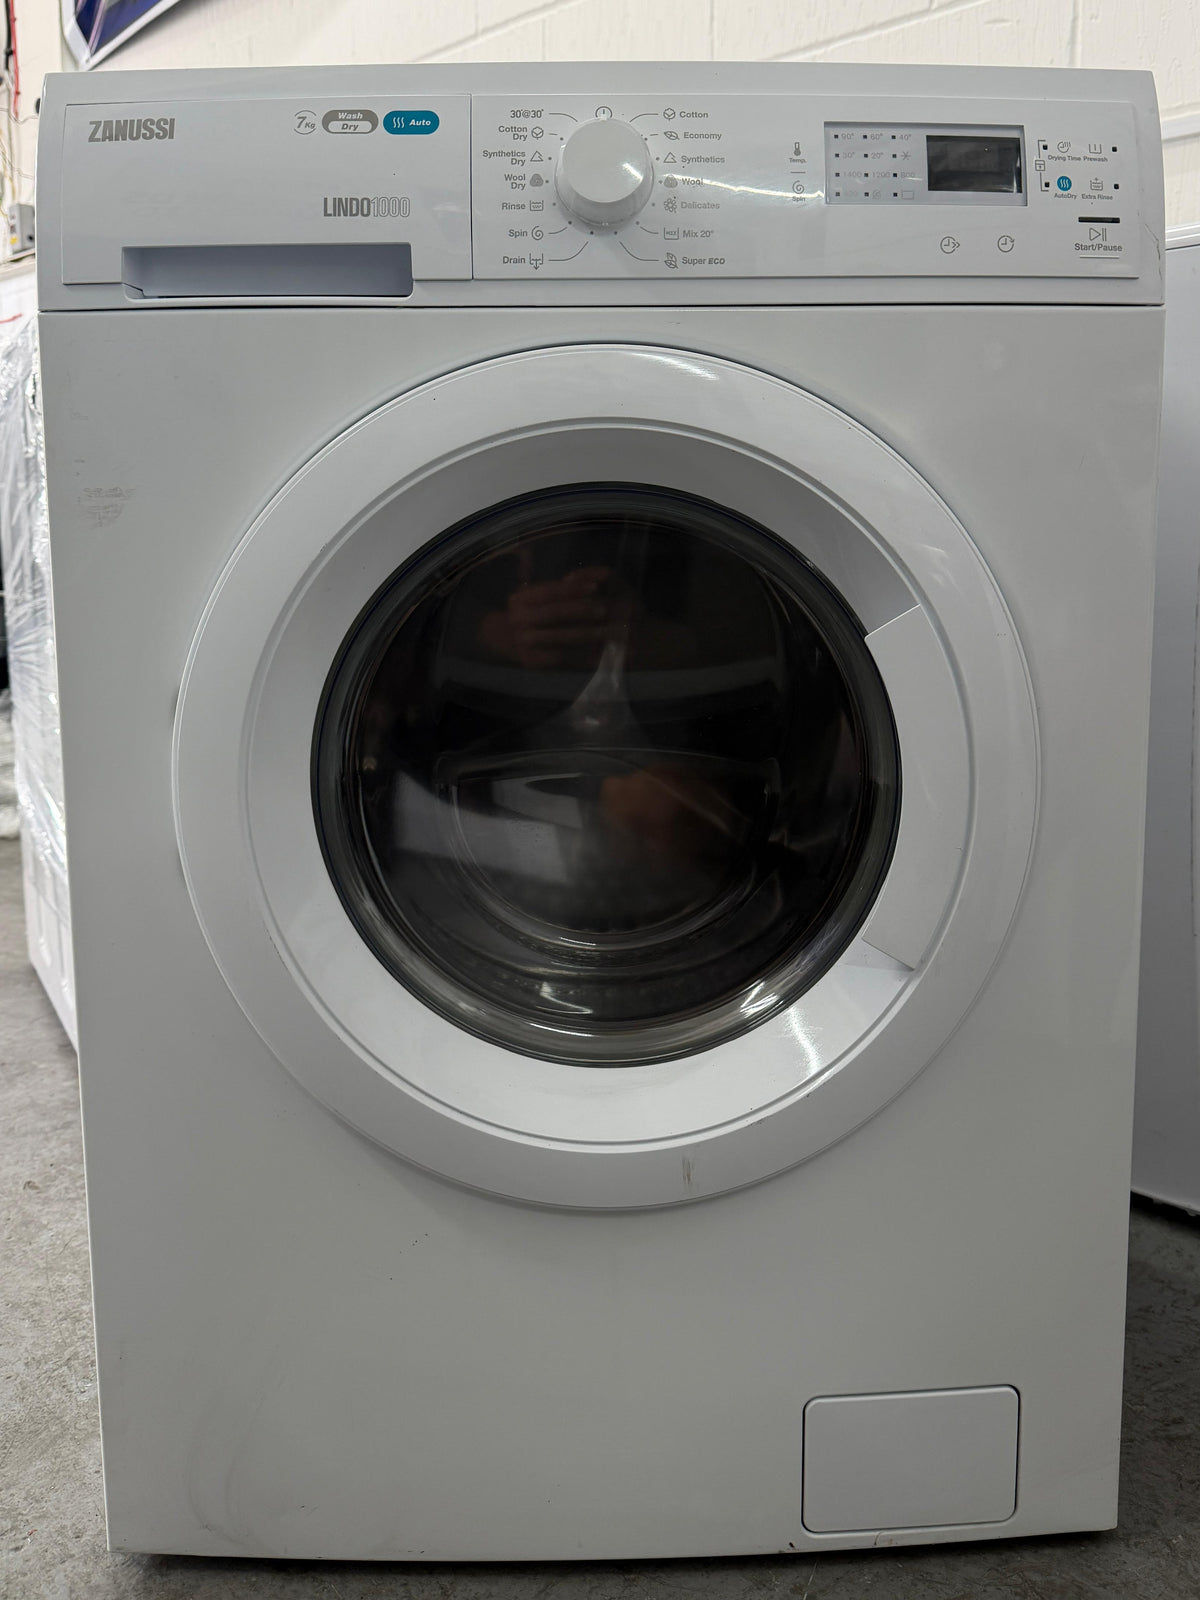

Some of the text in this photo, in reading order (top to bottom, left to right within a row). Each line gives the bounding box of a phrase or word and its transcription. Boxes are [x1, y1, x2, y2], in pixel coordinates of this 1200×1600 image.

[338, 112, 363, 120] Wash
[88, 118, 175, 142] ZANUSSI
[341, 123, 359, 131] Dry
[498, 125, 528, 133] Cotton
[513, 133, 528, 141] Dry
[683, 132, 722, 140] Economy
[482, 150, 526, 158] Synthetics
[511, 158, 526, 166] Dry
[681, 155, 725, 164] Synthetics
[511, 182, 526, 191] Dry
[323, 197, 410, 217] LINDO1000
[502, 202, 526, 210] Rinse
[680, 201, 720, 209] Delicates
[508, 229, 528, 238] Spin
[682, 230, 698, 238] Mix
[700, 230, 714, 238] 20°
[1074, 243, 1123, 252] Start/Pause
[502, 256, 526, 264] Drain
[682, 256, 706, 266] Super
